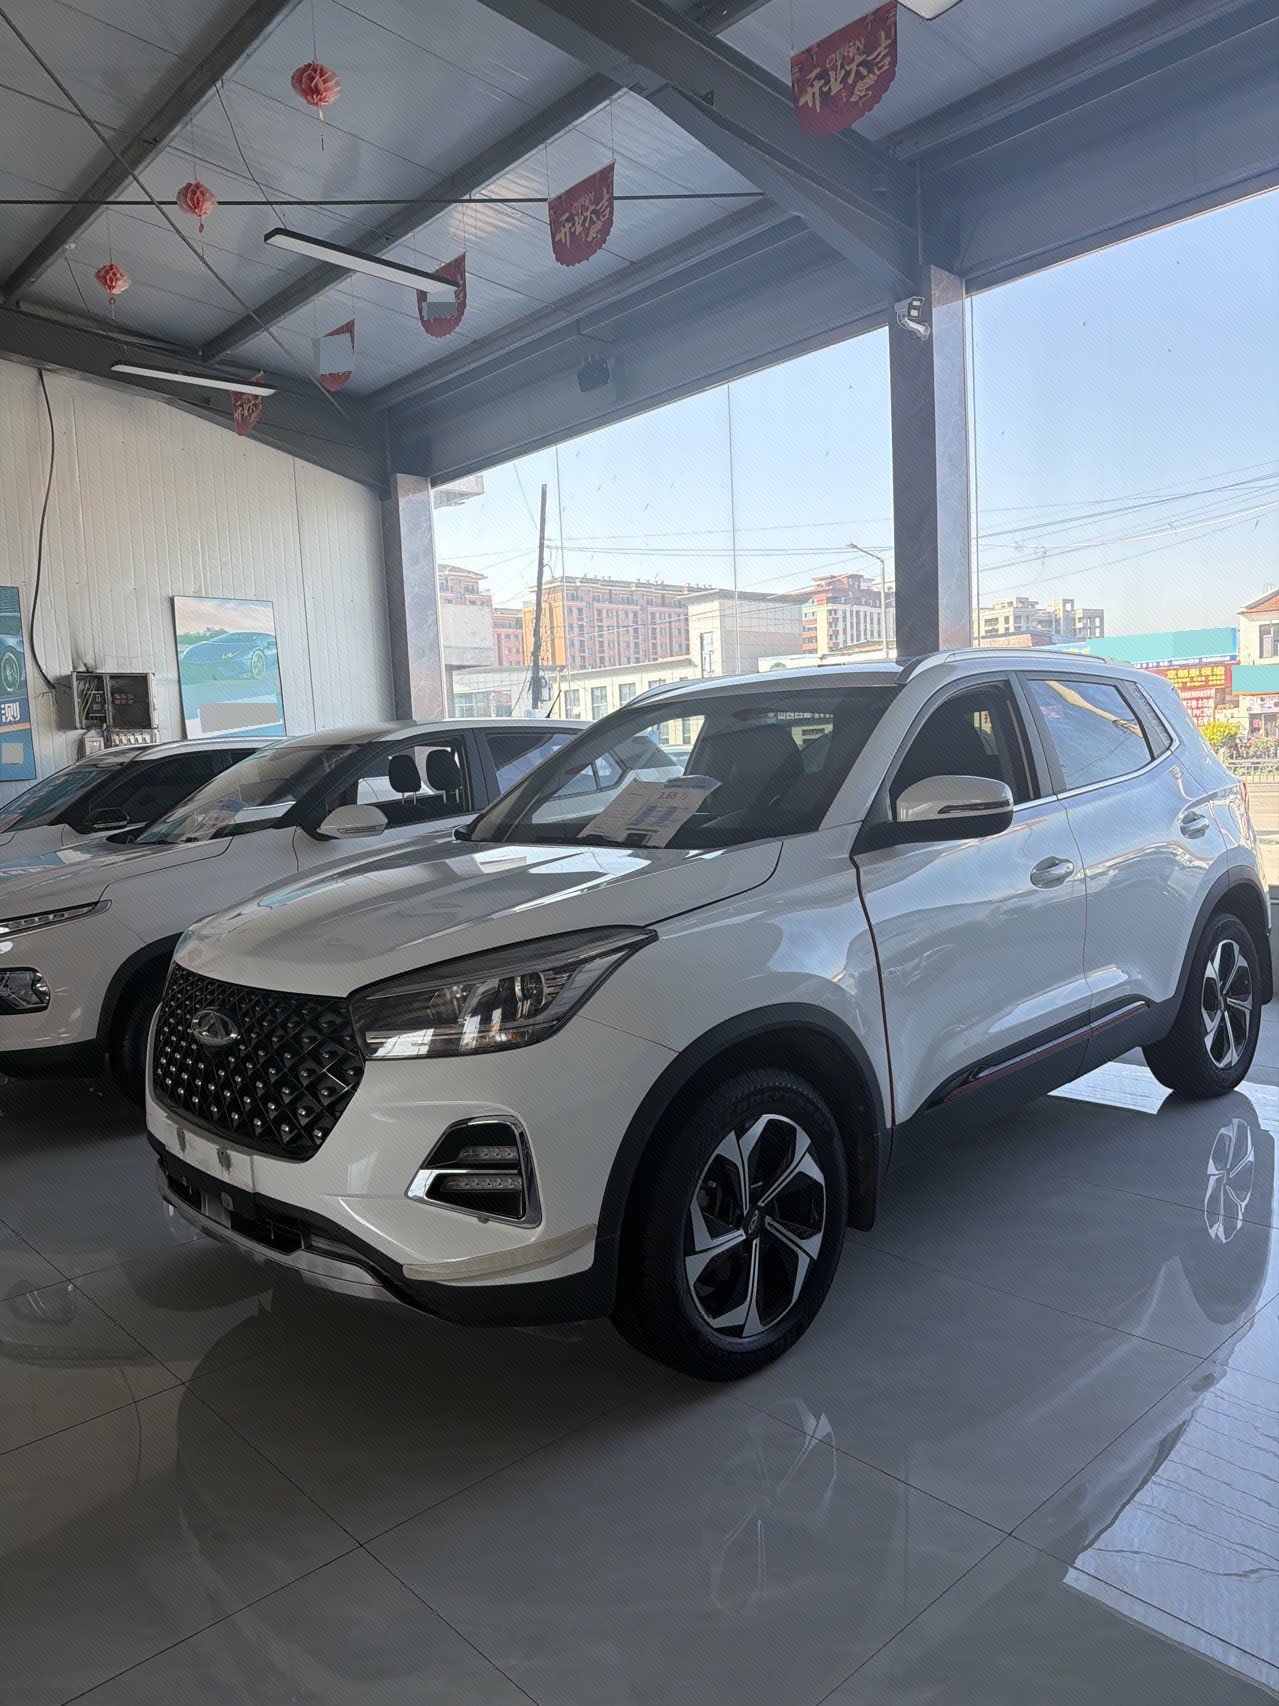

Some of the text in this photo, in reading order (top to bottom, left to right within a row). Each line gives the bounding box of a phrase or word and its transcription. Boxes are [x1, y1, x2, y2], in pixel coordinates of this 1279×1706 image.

[799, 30, 891, 113] 开业大吉
[555, 187, 611, 248] 开业大吉
[1, 701, 20, 723] 测
